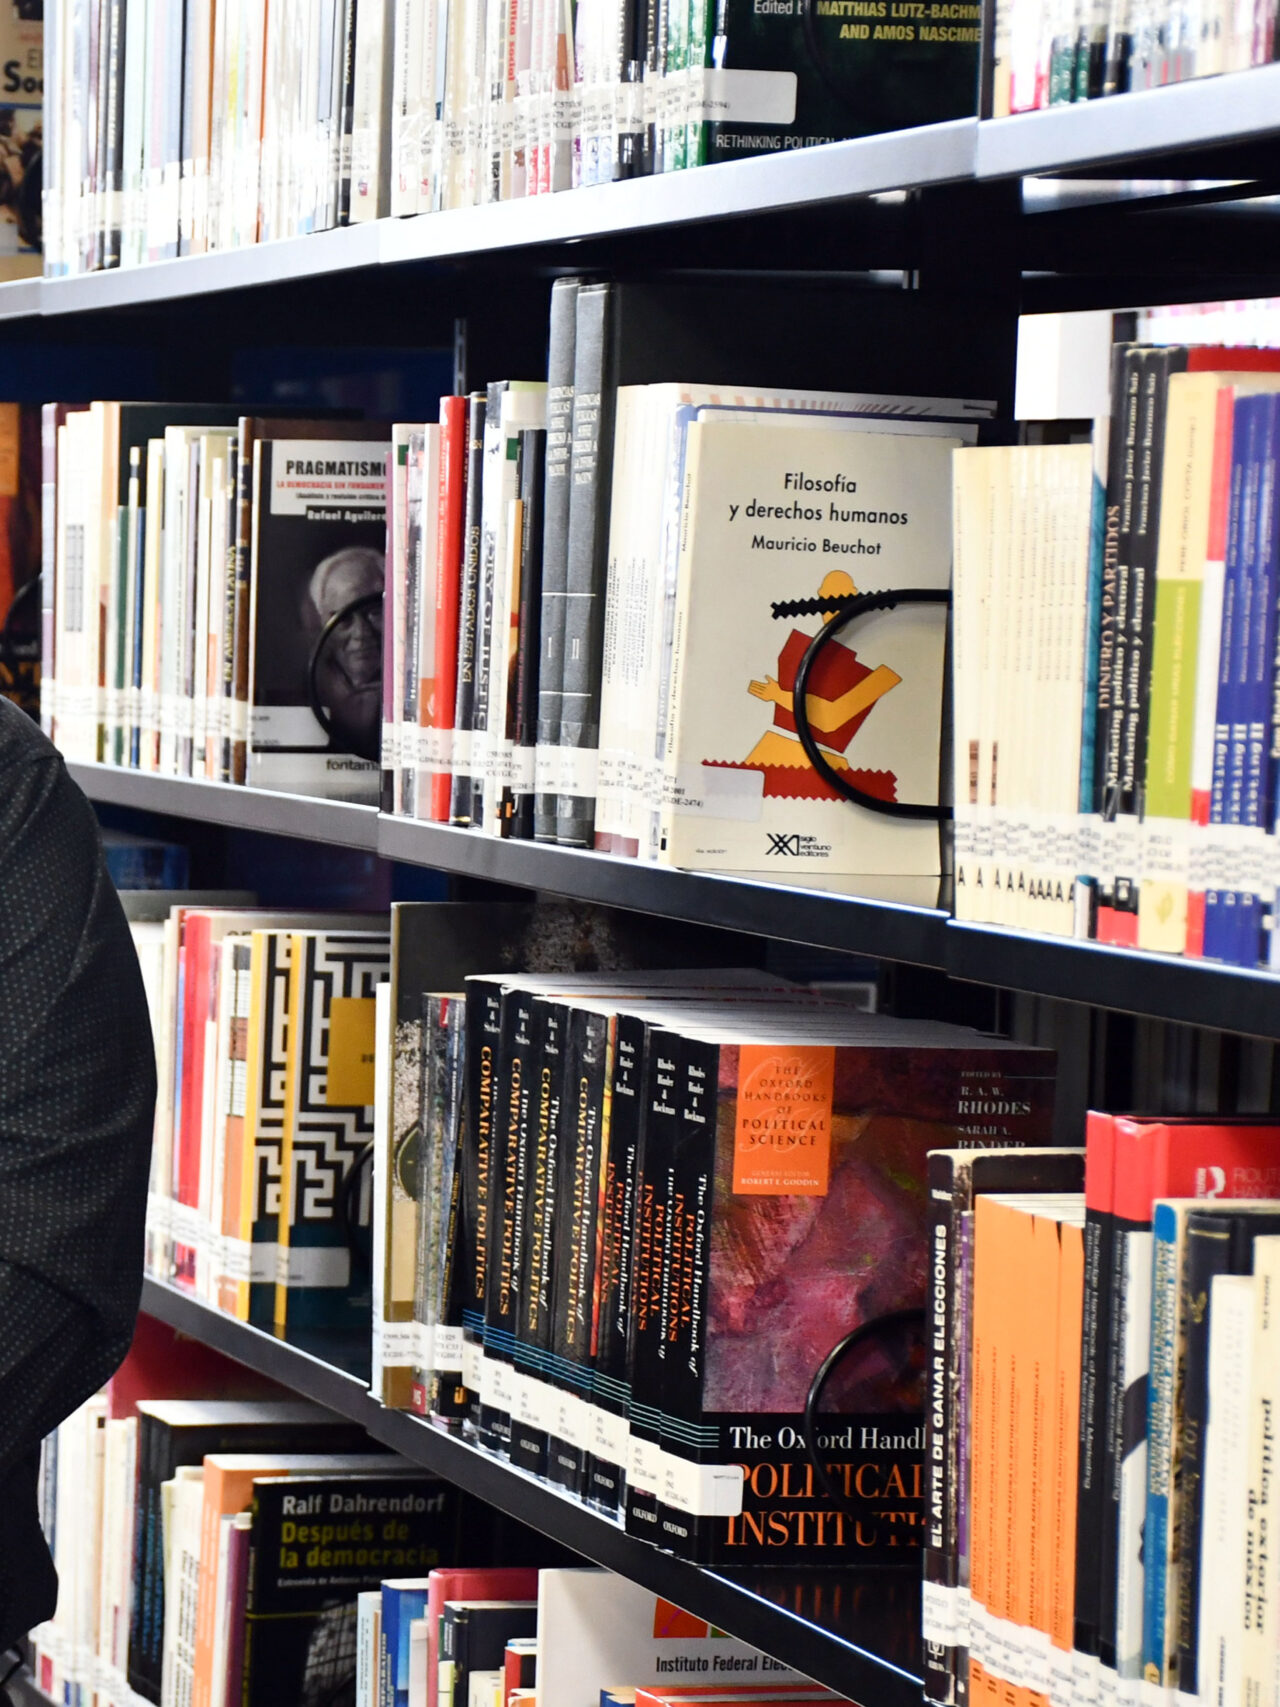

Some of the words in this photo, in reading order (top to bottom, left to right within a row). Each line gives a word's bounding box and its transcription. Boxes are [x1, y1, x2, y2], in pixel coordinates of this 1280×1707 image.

[753, 0, 793, 14] Edited
[817, 1, 886, 17] MATTHIAS
[839, 24, 870, 39] AND
[873, 25, 914, 40] AMOS
[716, 134, 781, 149] RETHINKING
[286, 460, 386, 476] PRAGMATISM
[1124, 449, 1135, 481] Javier
[1141, 450, 1152, 482] Javier
[784, 473, 857, 493] Filosofía
[307, 510, 341, 520] Rafael
[729, 504, 740, 521] y
[745, 499, 823, 521] derechos
[829, 502, 909, 525] humanos
[467, 525, 481, 584] UNIDOS
[751, 535, 817, 552] Mauricio
[822, 538, 882, 555] Beuchot
[1105, 505, 1121, 603] PARTIDOS
[1116, 565, 1130, 621] electoral
[1131, 567, 1146, 632] electoral
[463, 588, 478, 658] ESTADOS
[462, 661, 474, 683] EN
[1099, 630, 1114, 710] DINERO
[1113, 648, 1128, 705] político
[1126, 649, 1143, 709] político
[326, 757, 381, 771] fontam
[1107, 709, 1124, 788] Marketing
[1122, 712, 1140, 792] Marketing
[799, 850, 830, 858] editores
[759, 1079, 813, 1088] OXFORD
[774, 1066, 802, 1076] THE
[549, 1096, 561, 1129] The
[745, 1091, 826, 1101] HANDBOOKS
[776, 1105, 792, 1115] OF
[958, 1101, 1031, 1115] RHODES
[477, 1045, 493, 1199] COMPARATIVE
[585, 1106, 597, 1131] The
[742, 1119, 825, 1131] POLITICAL
[958, 1125, 997, 1135] SARAH
[504, 1057, 522, 1214] COMPARATIVE
[534, 1067, 552, 1226] COMPARATIVE
[750, 1135, 817, 1146] SCIENCE
[545, 1133, 558, 1194] Oxford
[570, 1076, 589, 1240] COMPARATIVE
[581, 1139, 594, 1201] Oxford
[626, 1144, 636, 1175] The
[697, 1173, 708, 1206] The
[741, 1178, 774, 1186] ROBERT
[784, 1179, 819, 1187] GOODIN
[622, 1177, 633, 1231] Oxford
[474, 1203, 488, 1300] POLITICS
[539, 1199, 555, 1286] Handbook
[610, 1181, 625, 1291] POLITICAL
[693, 1209, 706, 1266] Oxford
[499, 1218, 514, 1316] POLITICS
[577, 1210, 592, 1296] Handbook
[637, 1183, 654, 1332] INSTITUTIONS
[649, 1204, 665, 1318] POLITICAL
[668, 1193, 685, 1343] INSTITUTIONS
[1164, 1242, 1176, 1280] THE
[528, 1231, 543, 1331] POLITICS
[618, 1234, 631, 1314] Handbook
[680, 1213, 695, 1328] POLITICAL
[537, 1288, 549, 1311] of
[566, 1244, 582, 1344] POLITICS
[933, 1223, 948, 1352] ELECCIONES
[575, 1303, 586, 1325] of
[616, 1316, 626, 1338] of
[690, 1269, 703, 1353] Handbook
[1163, 1283, 1175, 1344] IRONY
[687, 1356, 699, 1378] of
[1162, 1345, 1174, 1371] OF
[932, 1356, 945, 1428] GANAR
[730, 1427, 772, 1449] The
[778, 1427, 852, 1449] Oxord
[932, 1433, 944, 1461] DE
[1260, 1398, 1275, 1507] política
[283, 1496, 321, 1515] Ralf
[329, 1493, 445, 1513] Dahrendorf
[932, 1465, 944, 1519] ARTE
[1248, 1488, 1258, 1520] de
[281, 1519, 374, 1545] Después
[382, 1519, 409, 1540] de
[663, 1520, 688, 1538] OXFORD
[931, 1527, 943, 1548] EL
[280, 1548, 298, 1568] la
[306, 1547, 440, 1567] democracia
[1243, 1529, 1256, 1631] méxico
[1254, 1517, 1270, 1636] exterior
[656, 1656, 709, 1673] Instituto
[713, 1655, 758, 1672] Federal
